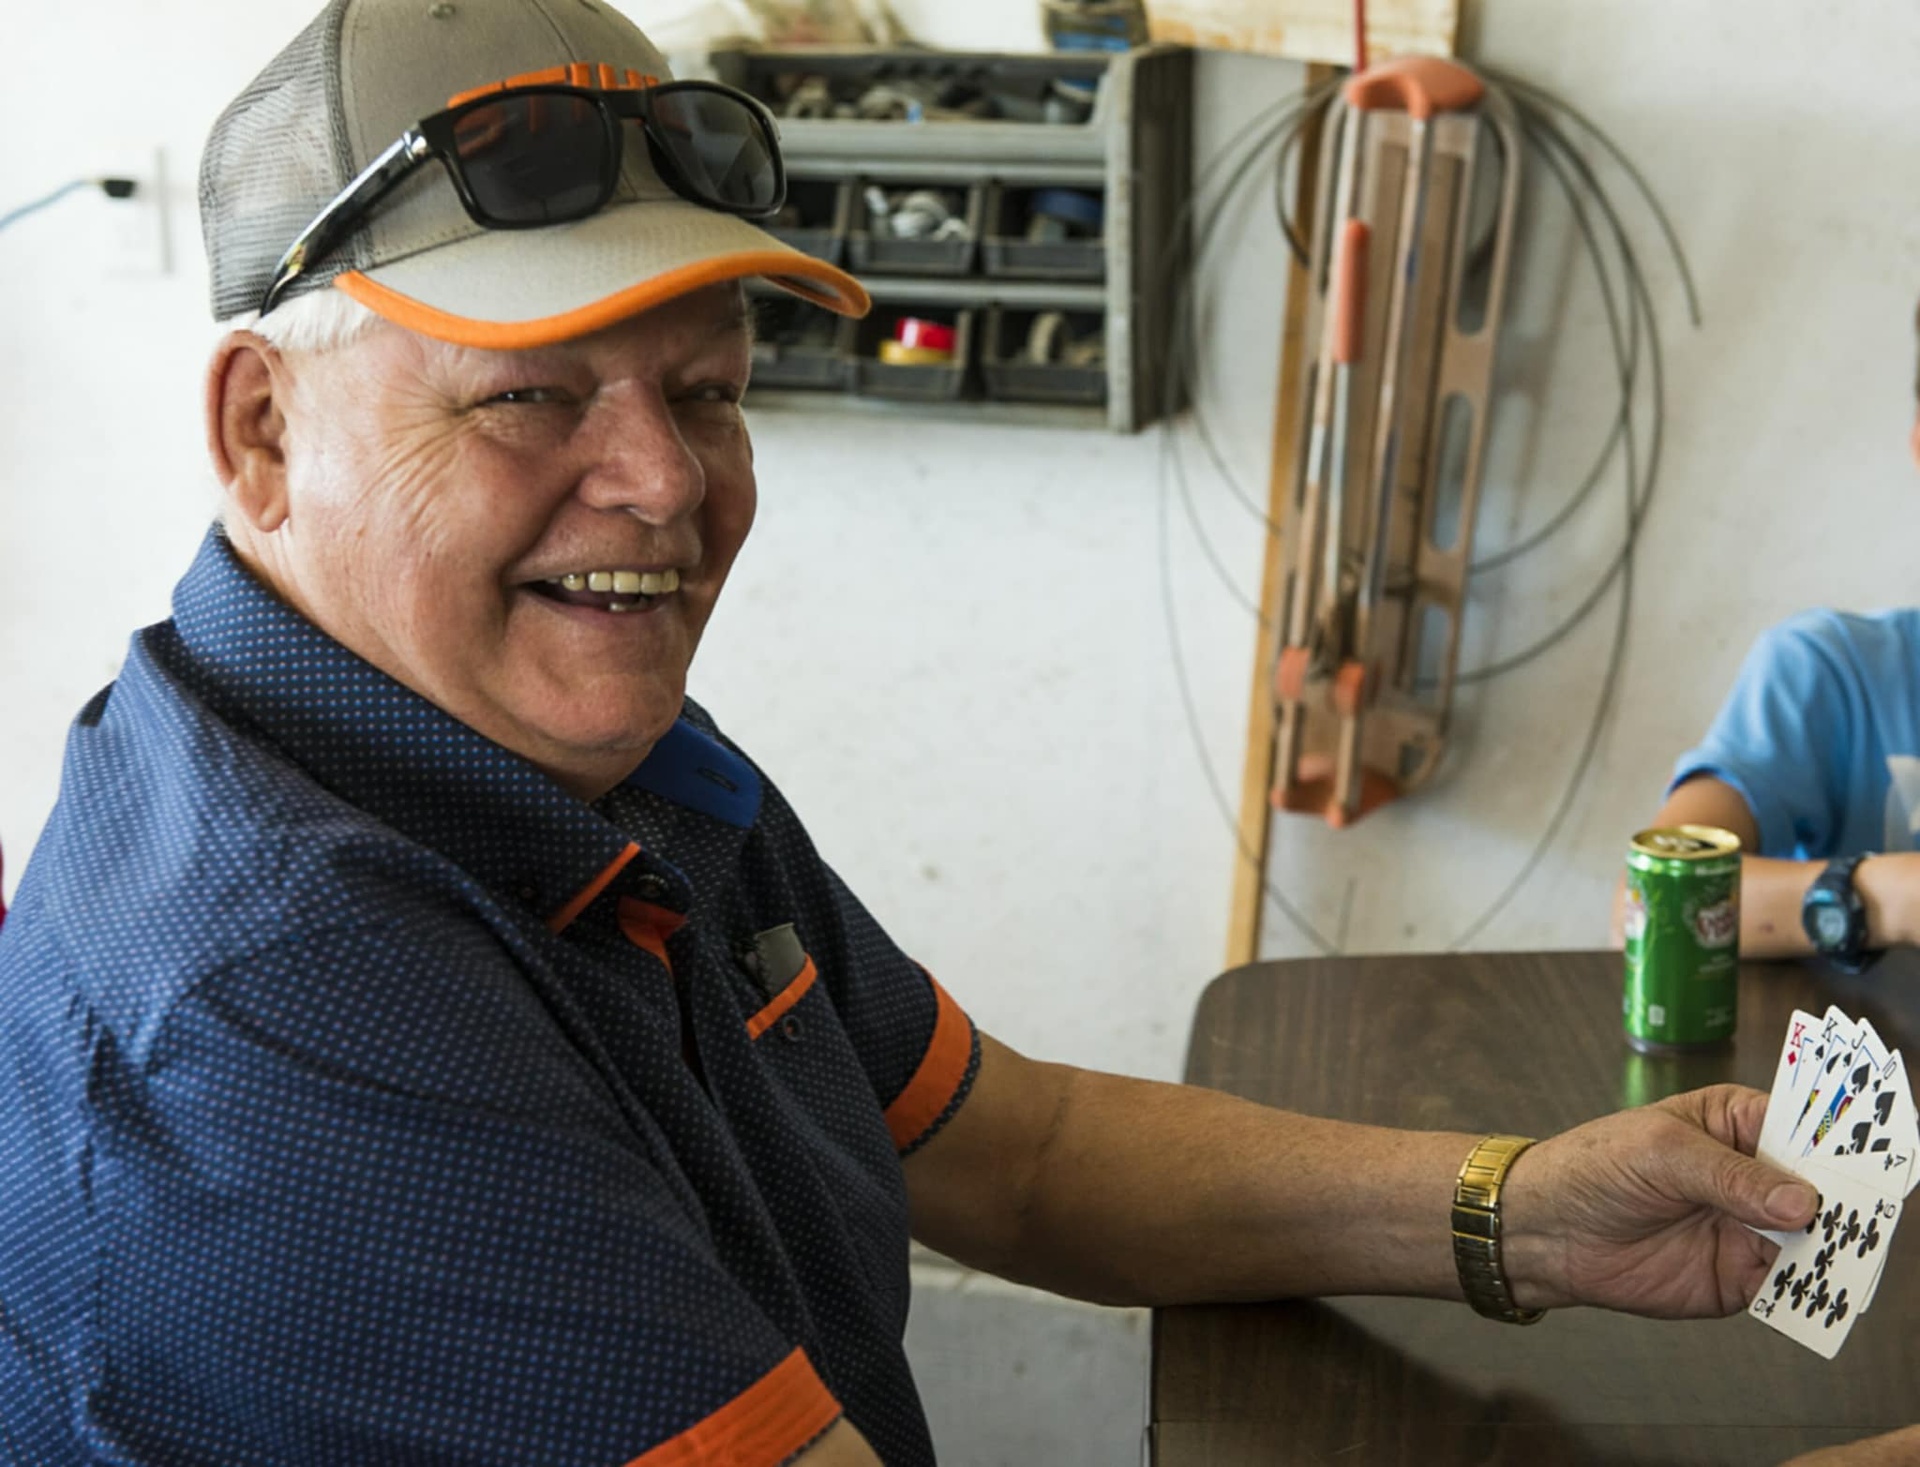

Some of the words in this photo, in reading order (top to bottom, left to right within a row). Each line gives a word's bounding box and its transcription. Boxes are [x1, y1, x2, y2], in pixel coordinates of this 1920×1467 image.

[1790, 1022, 1806, 1048] K
[1821, 1016, 1838, 1043] K
[1851, 1030, 1867, 1050] J
